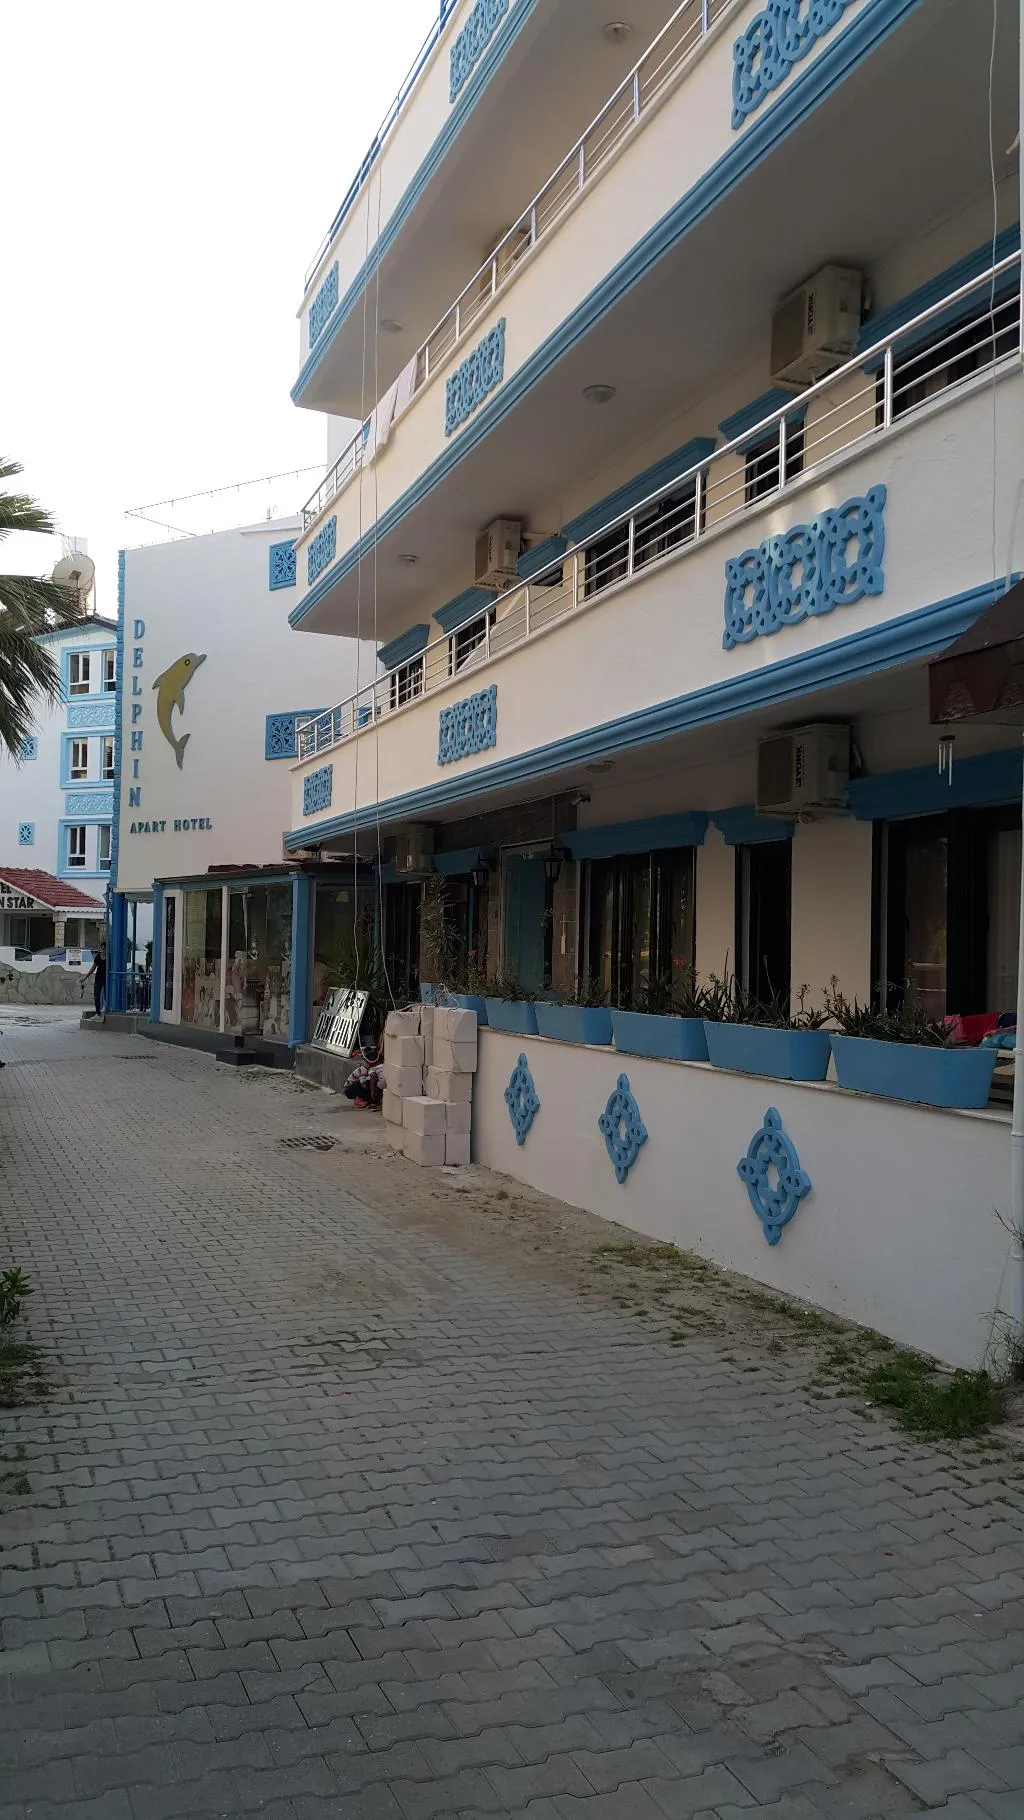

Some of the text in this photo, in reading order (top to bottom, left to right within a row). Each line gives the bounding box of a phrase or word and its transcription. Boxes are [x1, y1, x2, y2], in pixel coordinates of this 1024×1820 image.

[128, 618, 146, 808] DELPHIN
[129, 817, 213, 834] APART HOTEL
[6, 896, 35, 909] STAR
